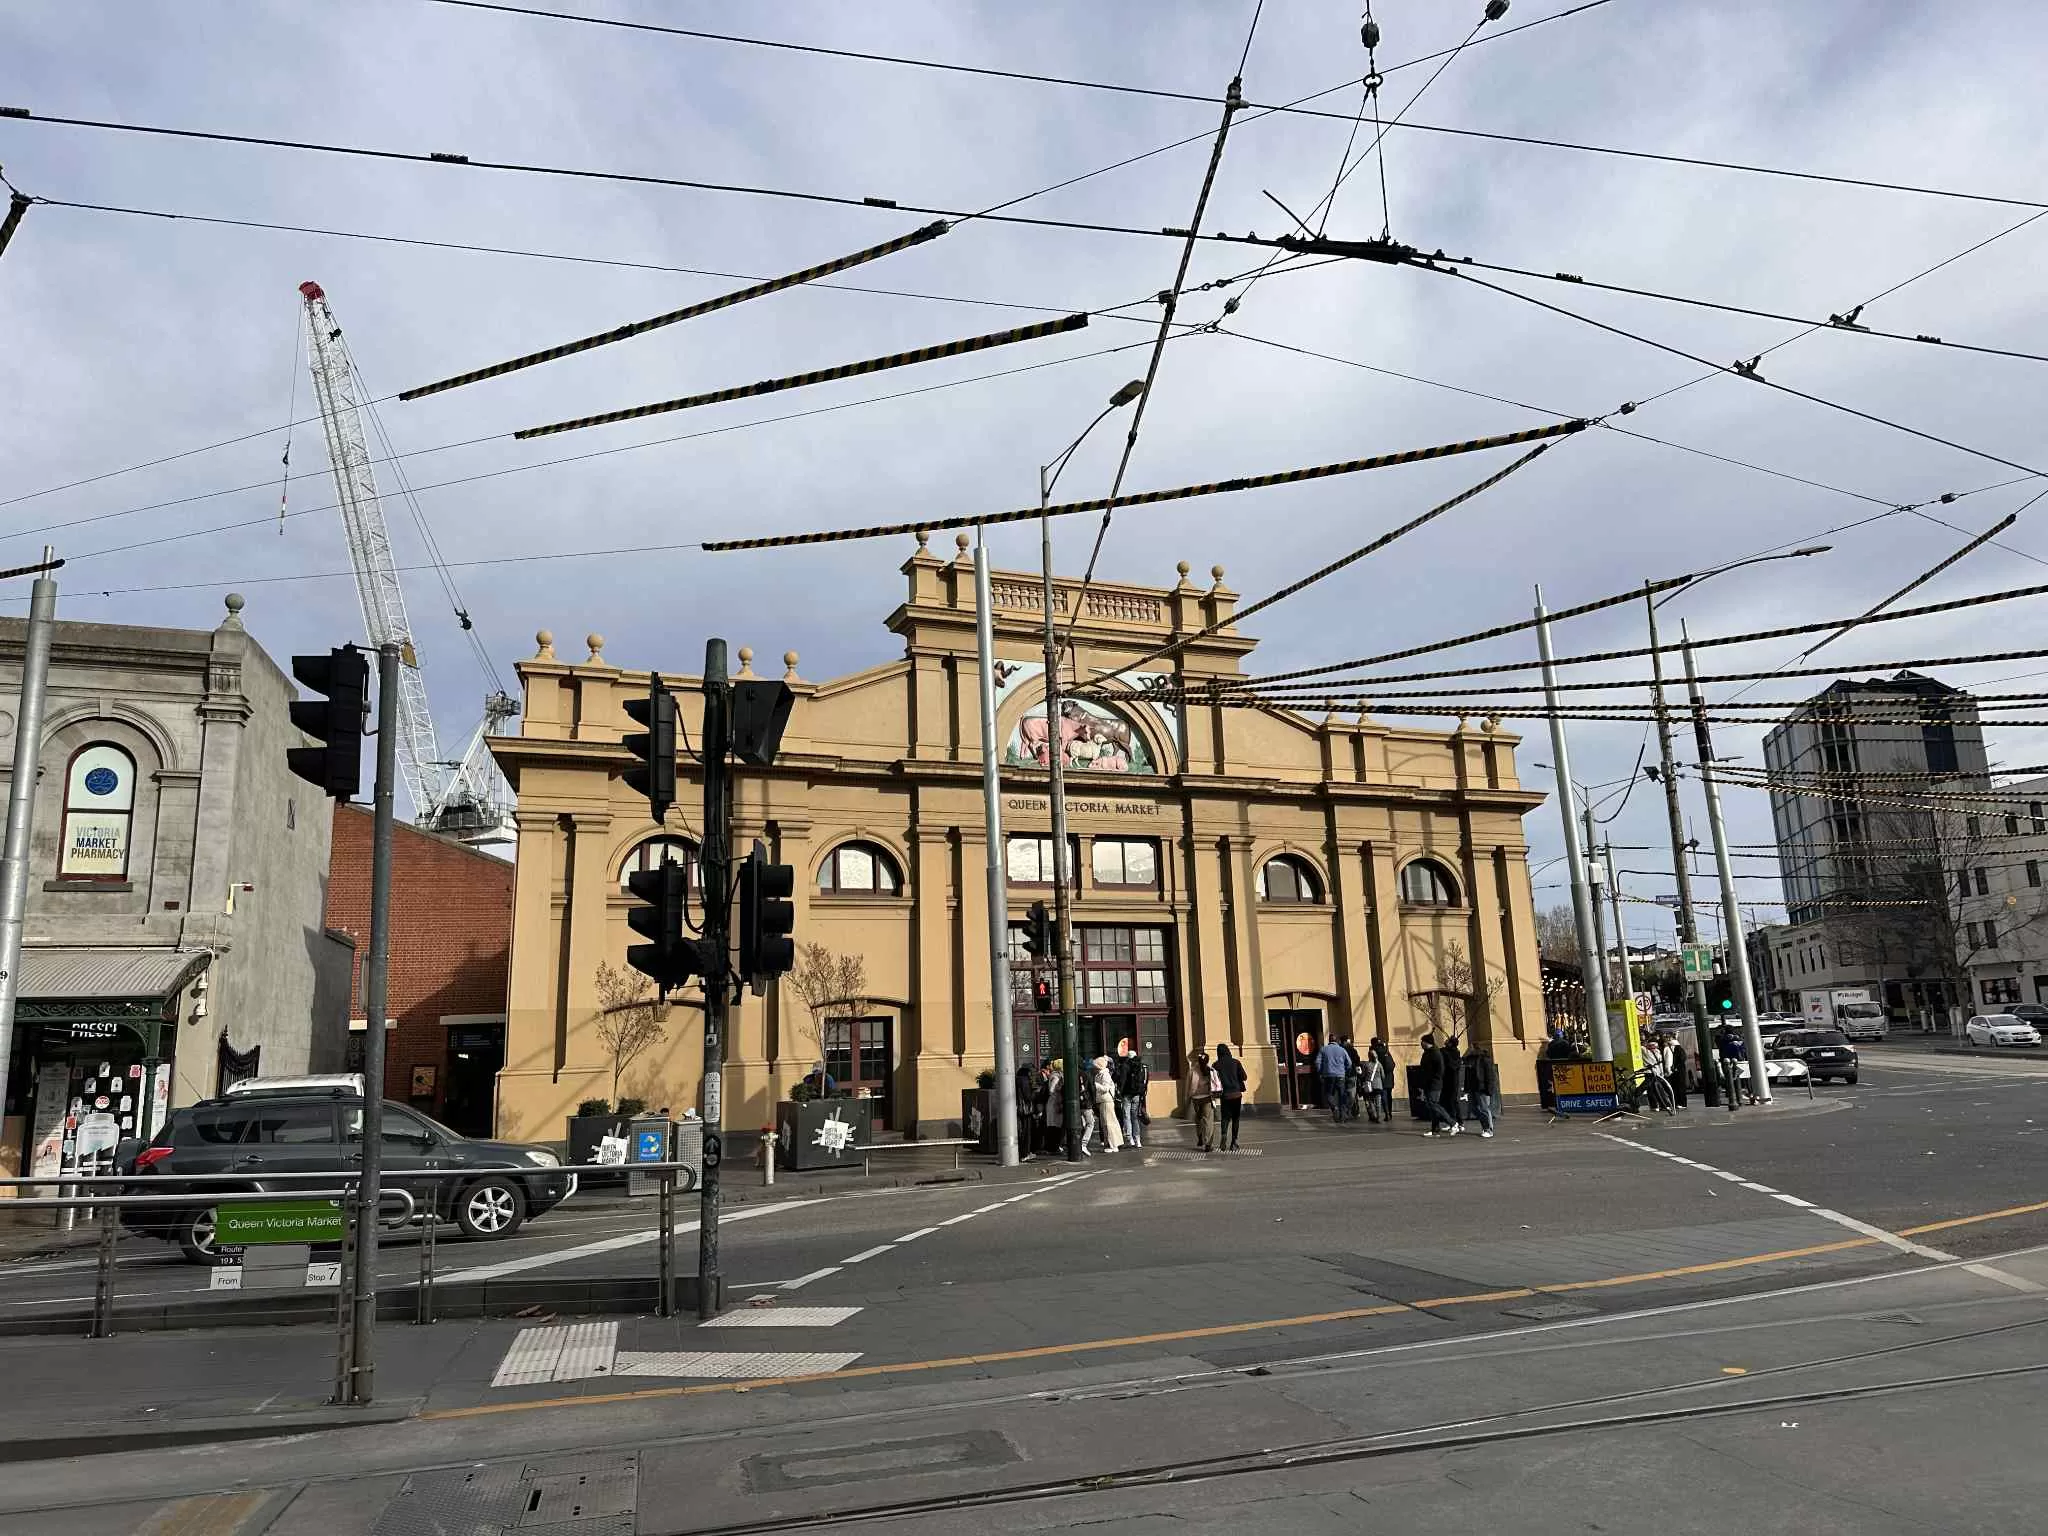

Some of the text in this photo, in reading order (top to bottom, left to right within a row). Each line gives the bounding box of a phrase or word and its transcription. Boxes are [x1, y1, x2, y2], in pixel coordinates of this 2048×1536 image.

[1008, 800, 1161, 815] QUEEN CTORIA MARKET
[77, 826, 120, 838] VICTORIA
[76, 837, 117, 848] MARKET
[71, 848, 125, 859] PHARMACY
[1588, 1064, 1606, 1073] END
[1587, 1073, 1611, 1082] ROAD
[1588, 1083, 1613, 1092] WORK
[1560, 1098, 1613, 1109] DRIVE SAFELY
[228, 1215, 342, 1229] Queen Victoria Market
[307, 1267, 337, 1282] Stop 7
[217, 1277, 238, 1285] From
